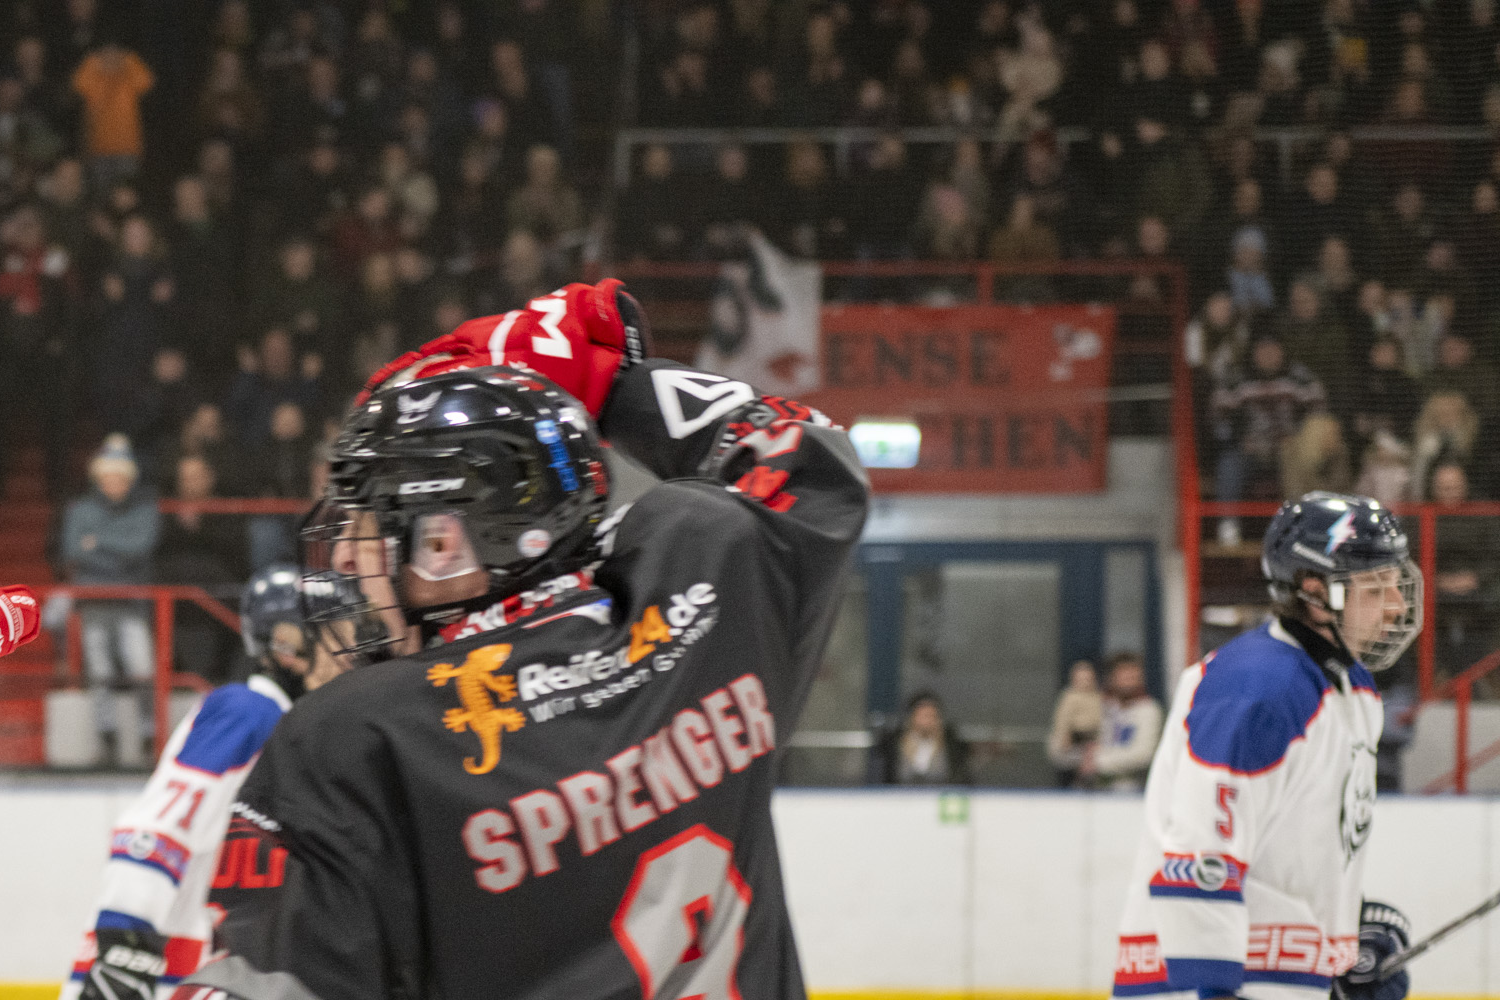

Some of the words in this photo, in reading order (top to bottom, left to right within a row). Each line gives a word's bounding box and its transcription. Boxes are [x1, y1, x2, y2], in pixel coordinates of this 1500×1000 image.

[156, 779, 206, 832] 71
[461, 673, 776, 893] SPRENGER
[1216, 782, 1237, 840] 5
